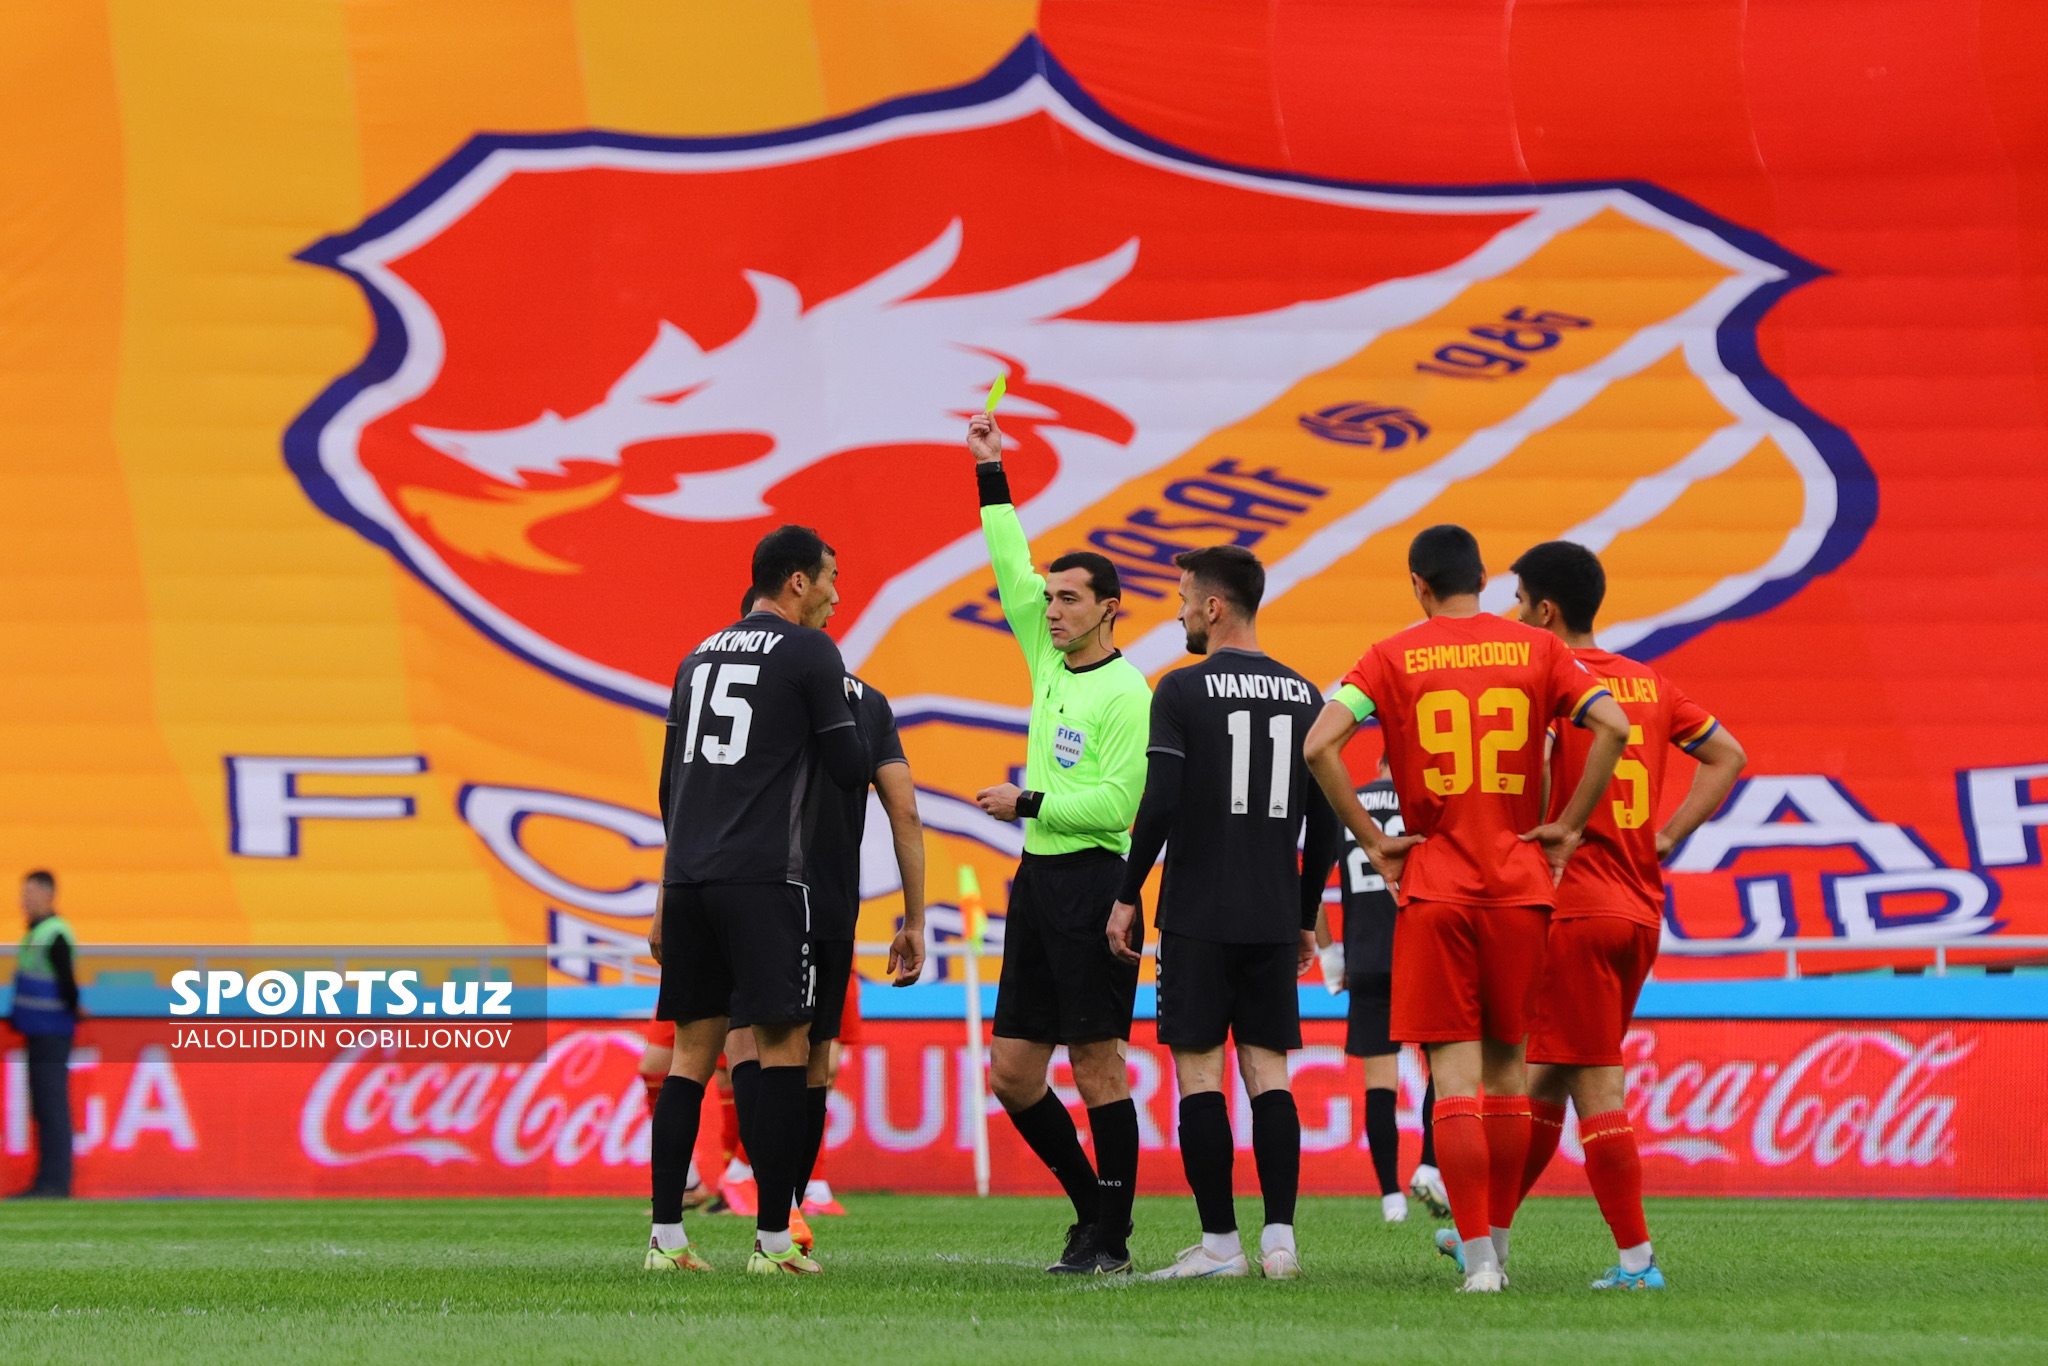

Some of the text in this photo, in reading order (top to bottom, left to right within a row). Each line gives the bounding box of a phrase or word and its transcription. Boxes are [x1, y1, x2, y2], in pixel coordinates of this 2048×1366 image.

[1416, 305, 1594, 382] 1985
[1404, 641, 1531, 674] ESHMURODOV
[683, 662, 761, 766] 15
[1205, 673, 1312, 705] IVANOVICH
[1055, 743, 1080, 756] REFEREE
[1058, 727, 1082, 744] FIFA
[1416, 687, 1531, 796] 92
[1227, 710, 1293, 819] 11
